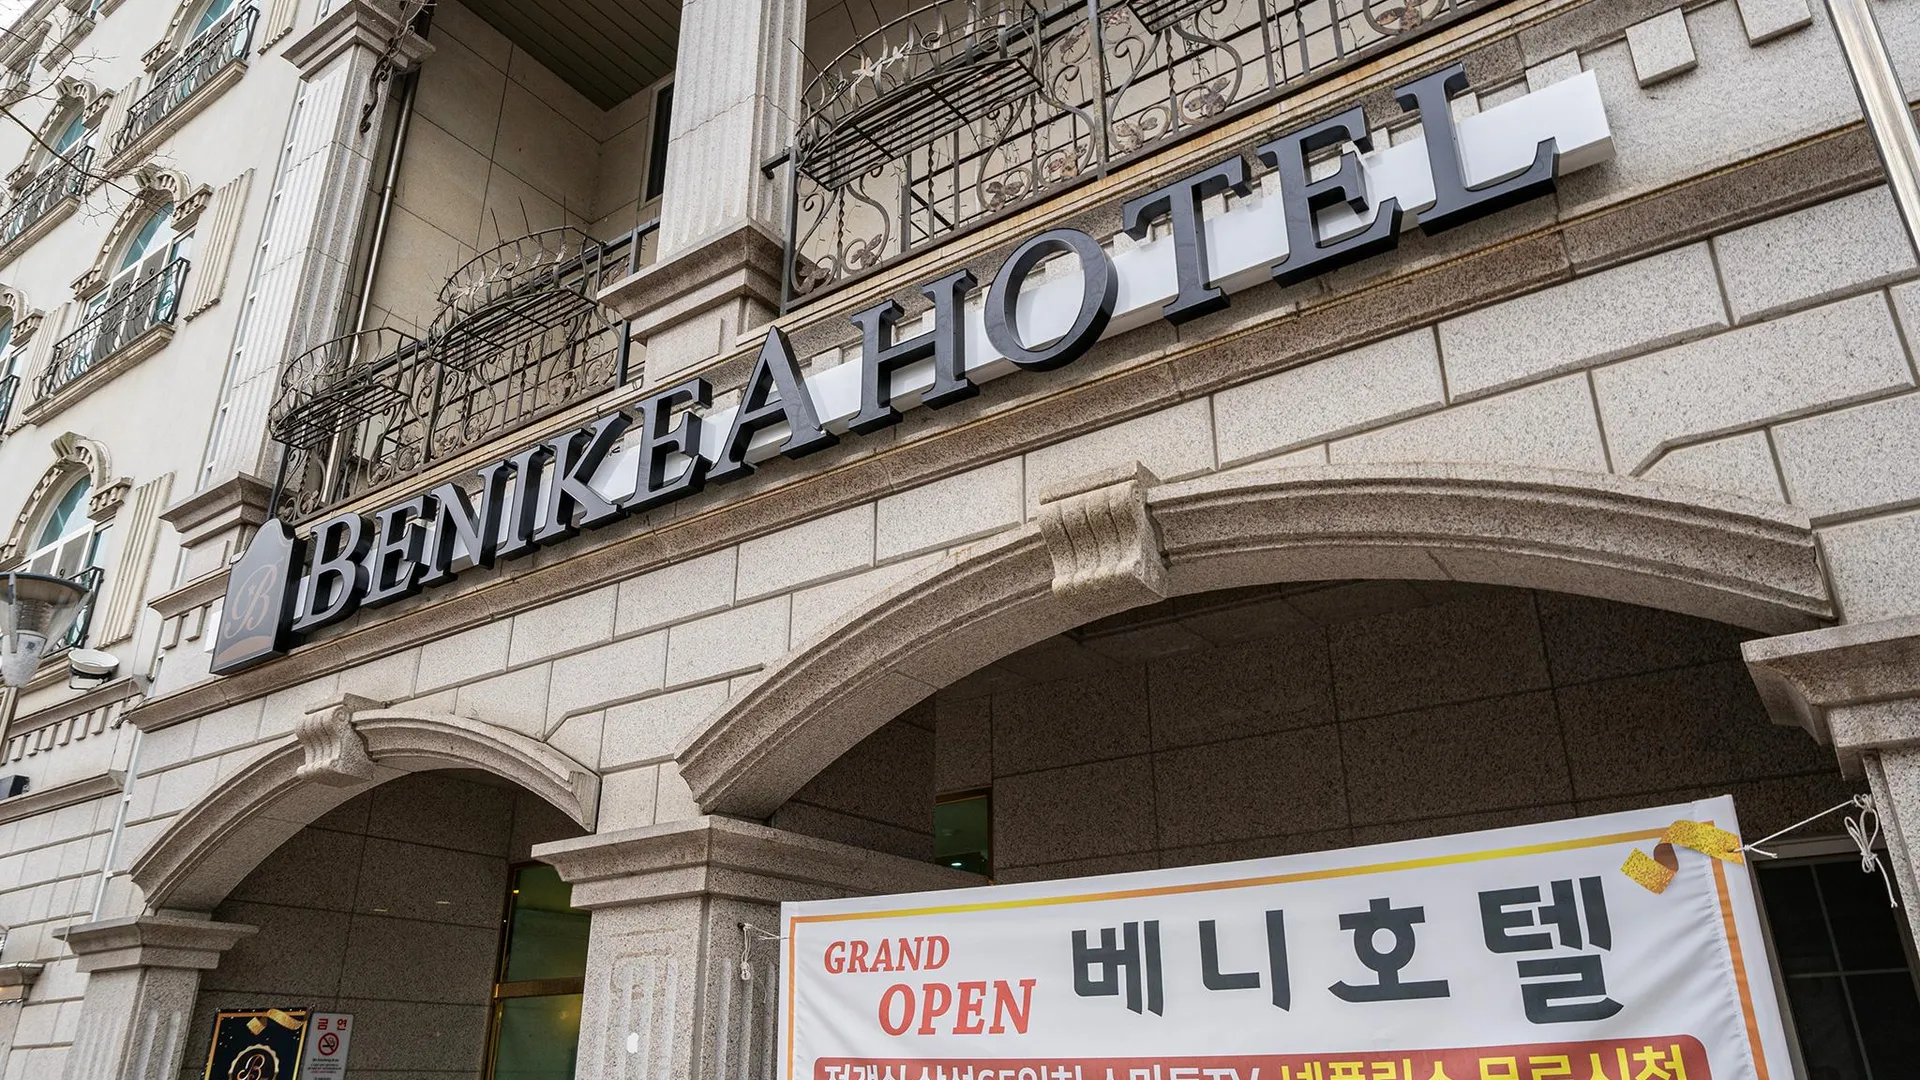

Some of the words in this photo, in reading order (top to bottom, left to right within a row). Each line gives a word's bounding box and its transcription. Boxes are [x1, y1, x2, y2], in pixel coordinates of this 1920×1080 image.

[824, 935, 951, 975] GRAND
[1072, 876, 1624, 1024] 베니호텔
[878, 978, 1037, 1036] OPEN
